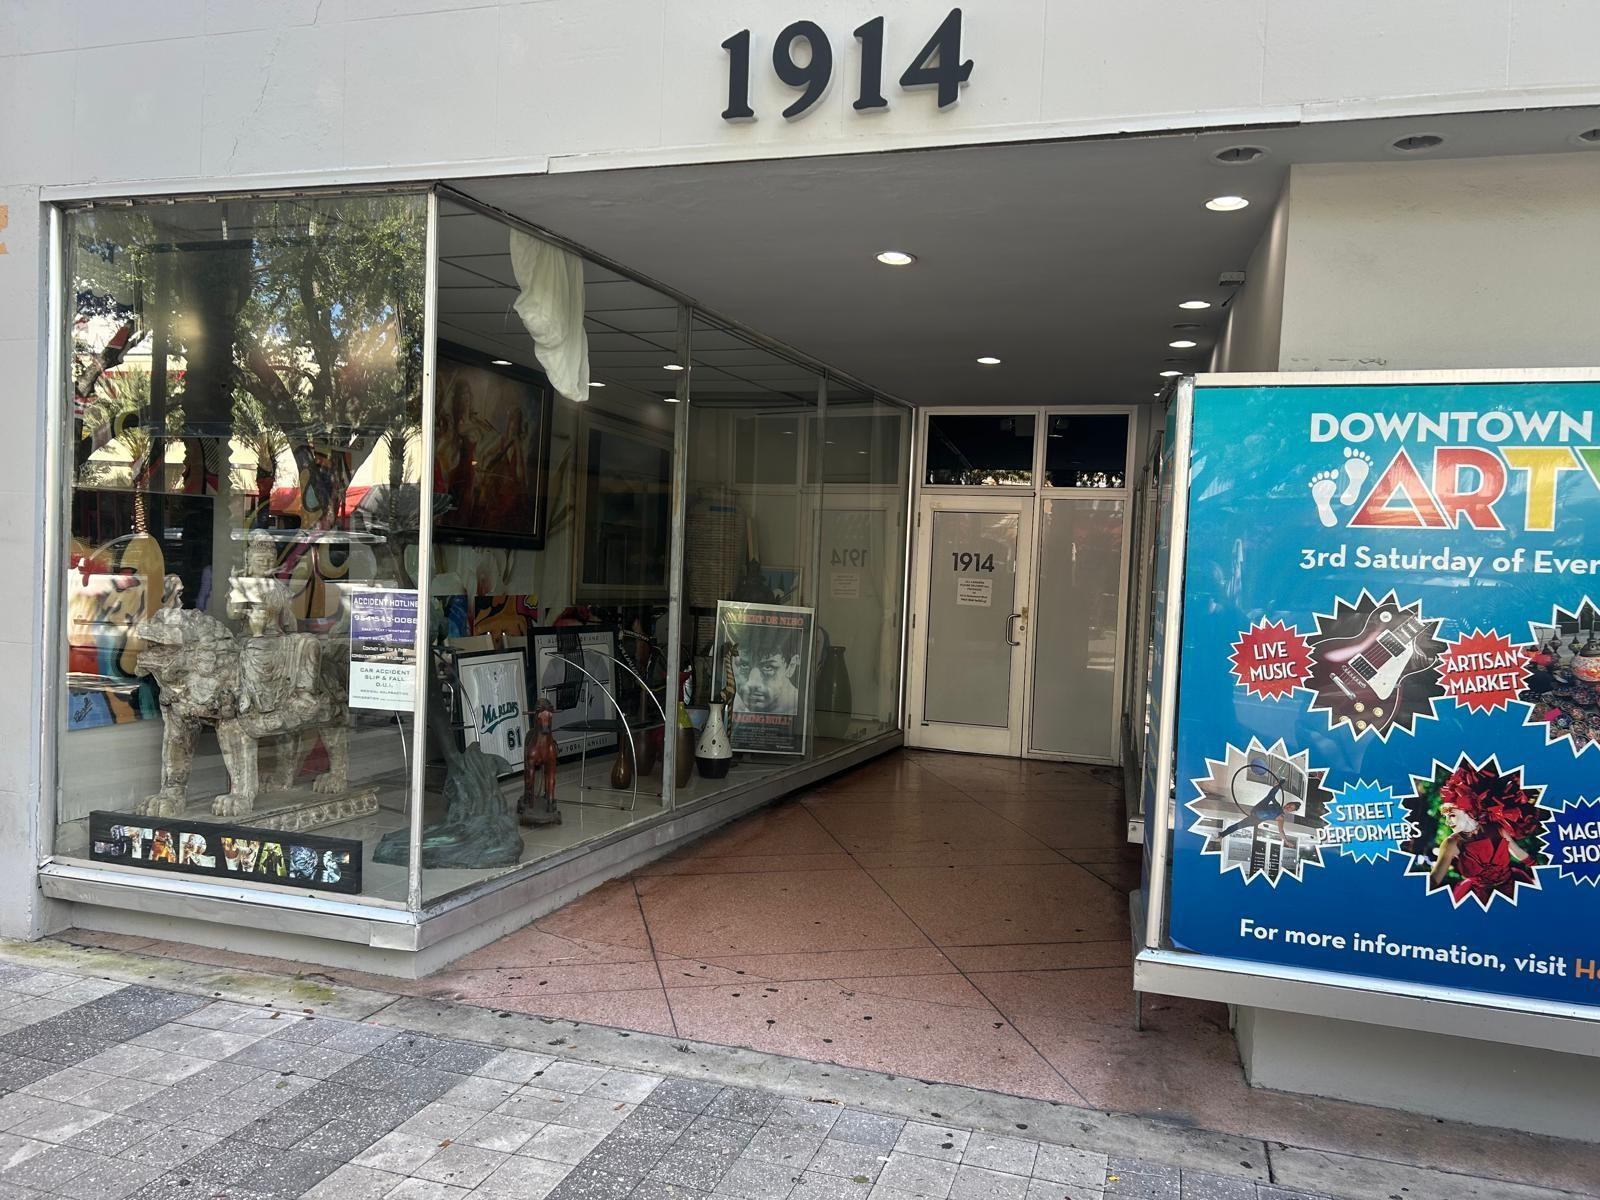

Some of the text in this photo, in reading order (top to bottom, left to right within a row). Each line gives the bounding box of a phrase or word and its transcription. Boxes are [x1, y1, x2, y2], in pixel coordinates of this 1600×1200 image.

[721, 8, 974, 119] 1914
[1309, 410, 1593, 443] DOWNTOWN
[1345, 445, 1600, 532] ART
[952, 552, 994, 572] 1914
[1299, 544, 1347, 570] 3rd
[1354, 546, 1484, 577] Saturday
[1492, 548, 1526, 573] of
[353, 597, 388, 606] ACCIDENT
[1253, 641, 1288, 660] LIVE
[1447, 650, 1518, 673] ARTISAN
[1250, 661, 1298, 681] MUSIC
[1449, 672, 1519, 694] MARKET
[507, 727, 522, 750] 61
[1336, 801, 1394, 821] STREET
[1316, 821, 1422, 844] PERFORMERS
[94, 824, 350, 884] STAR WARS
[1562, 844, 1600, 864] SHO
[1240, 918, 1279, 941] For
[1285, 929, 1346, 949] more
[1353, 932, 1507, 972] information,
[1514, 953, 1567, 977] visit
